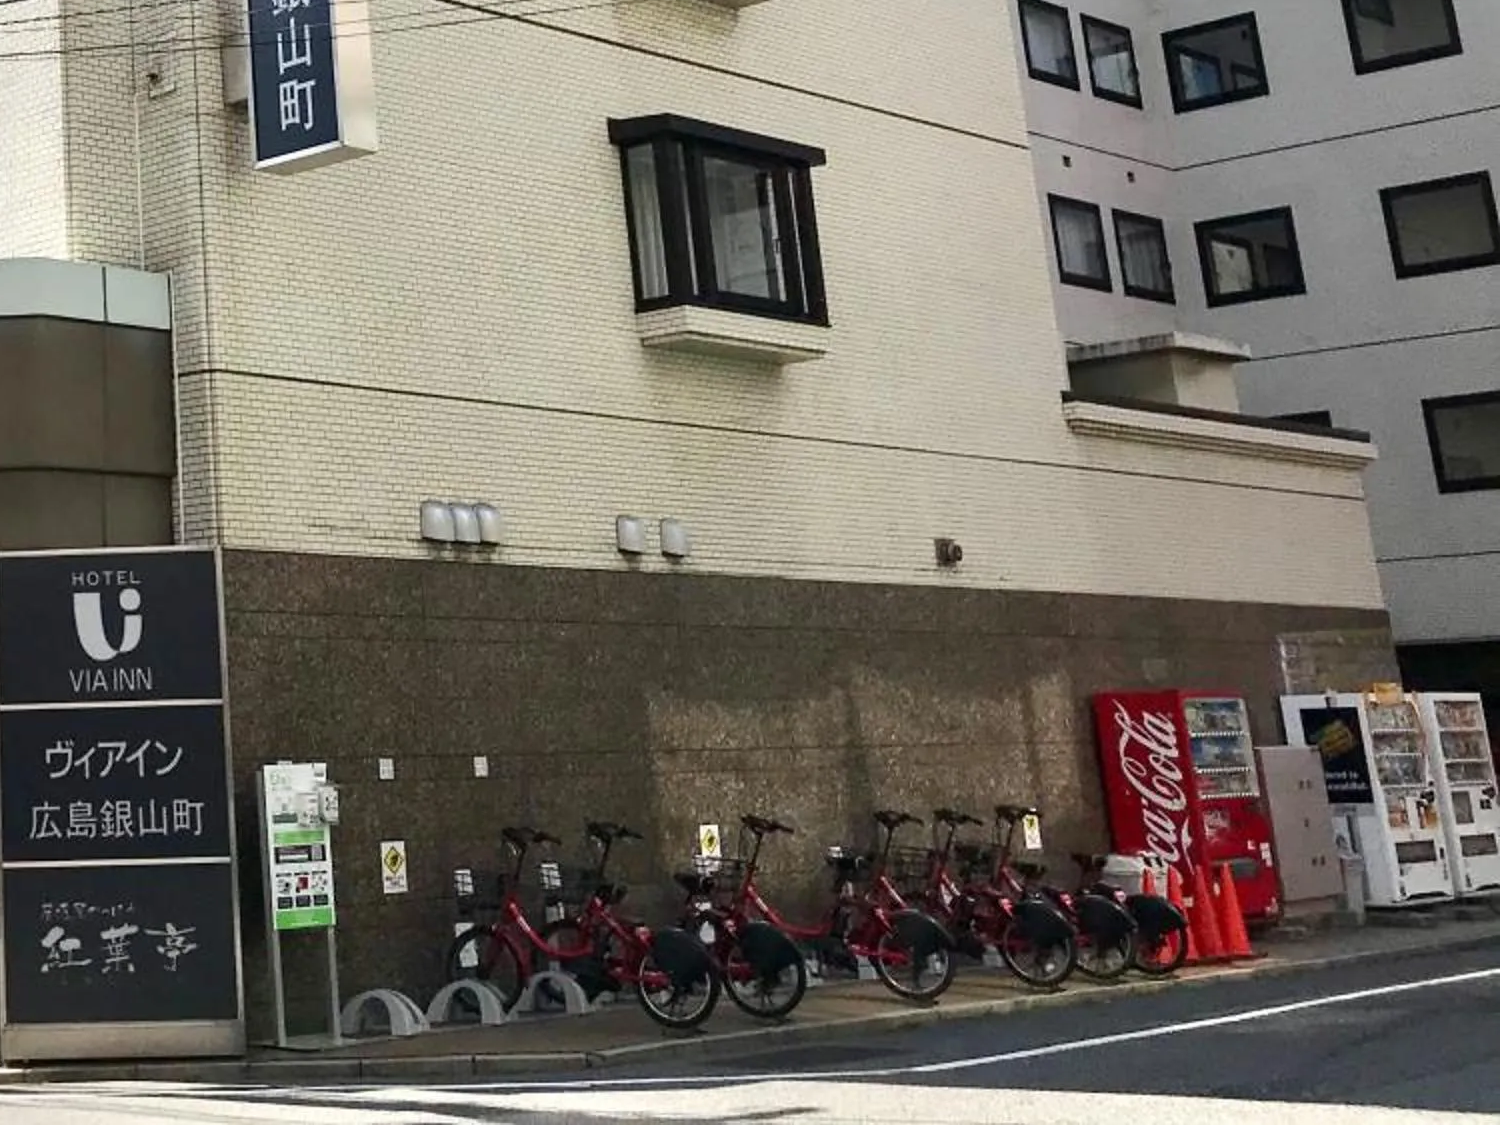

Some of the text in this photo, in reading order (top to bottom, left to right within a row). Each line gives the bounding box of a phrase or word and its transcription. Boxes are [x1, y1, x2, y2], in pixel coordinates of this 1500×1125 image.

[72, 571, 141, 586] HOTEL
[45, 739, 183, 779] ヴィアイン
[29, 798, 204, 839] 広島銀山町
